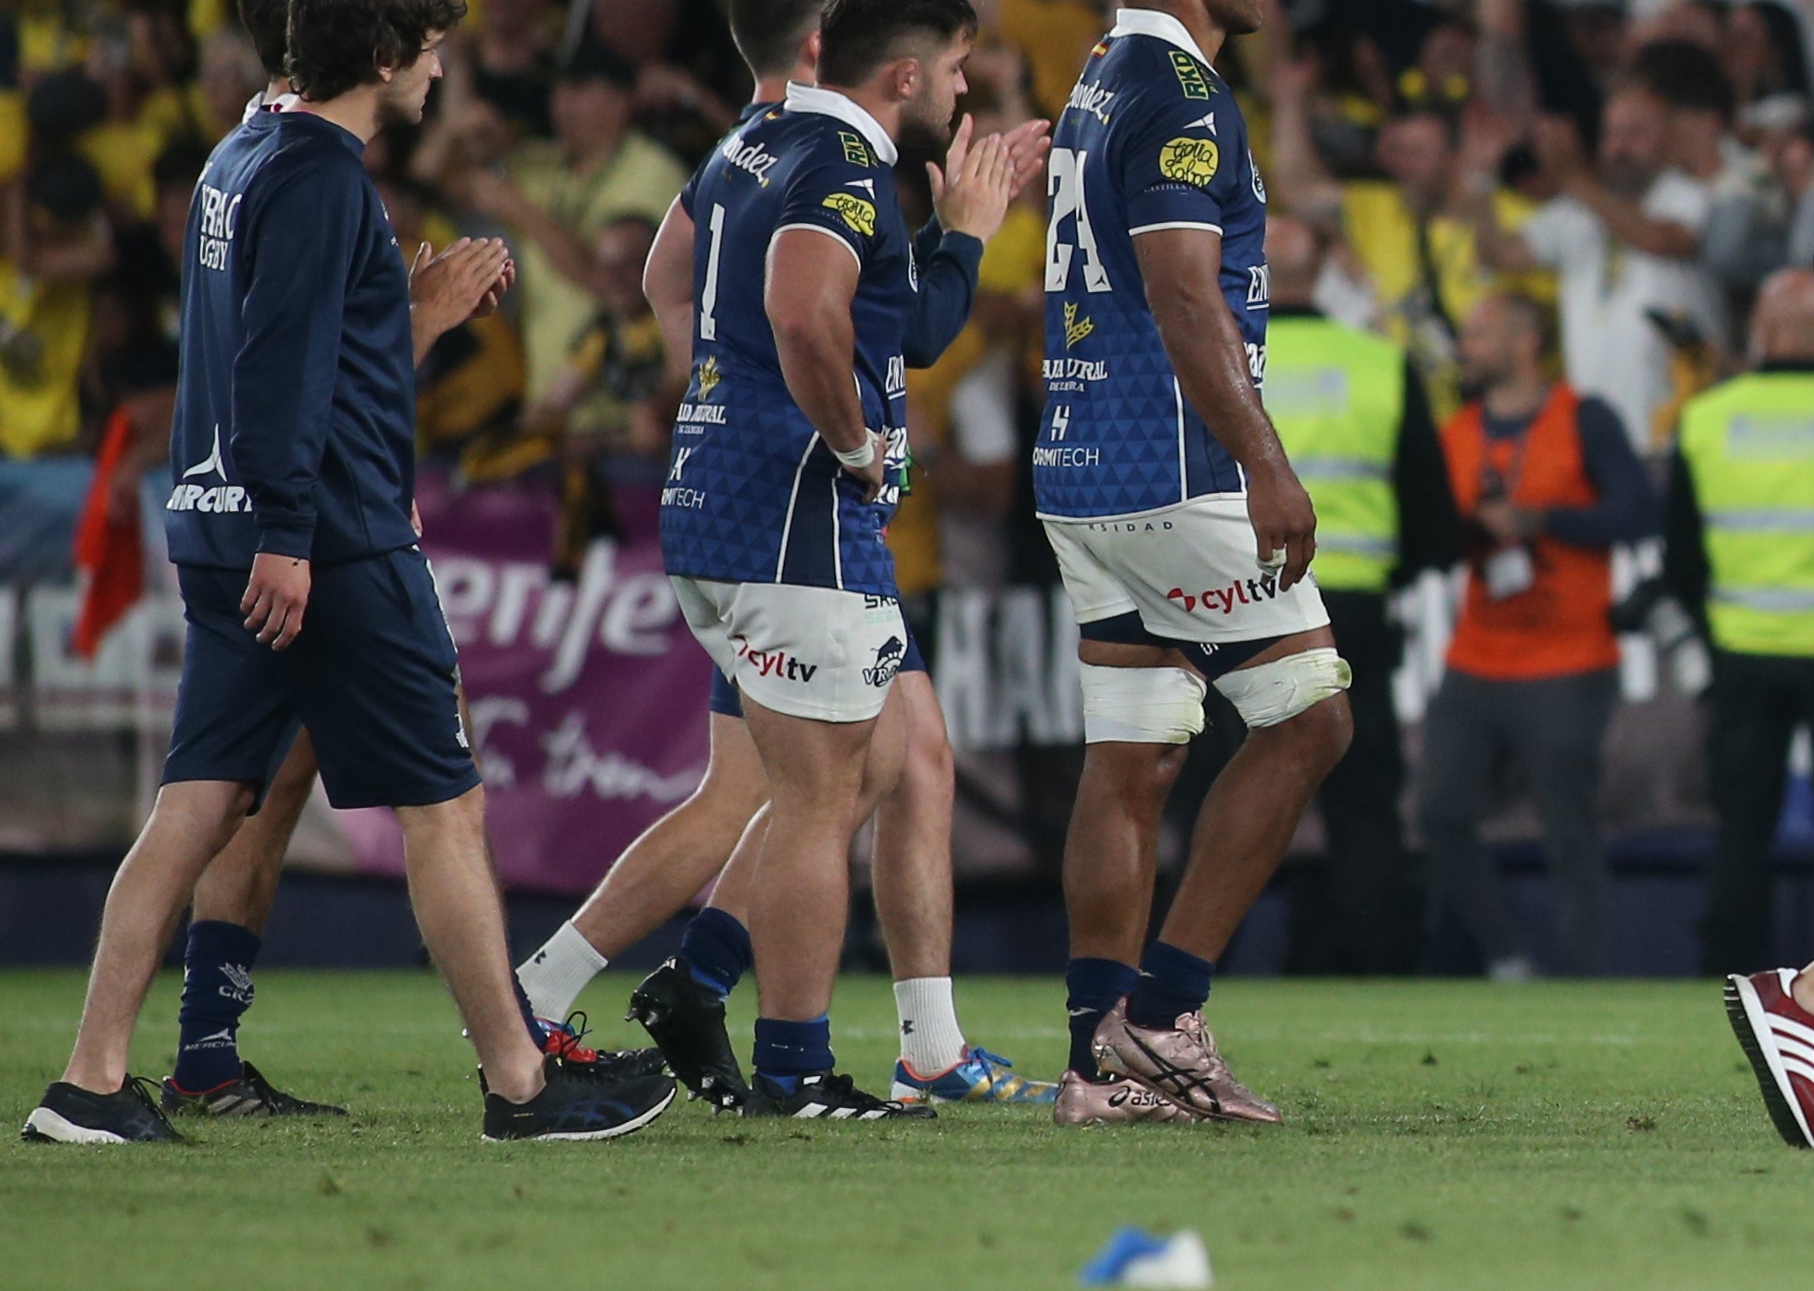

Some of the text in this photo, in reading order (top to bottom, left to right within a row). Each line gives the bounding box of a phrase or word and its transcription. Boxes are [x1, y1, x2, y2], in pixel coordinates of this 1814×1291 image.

[1170, 51, 1209, 98] RKD
[701, 202, 725, 341] 1
[1201, 578, 1277, 614] cyltv
